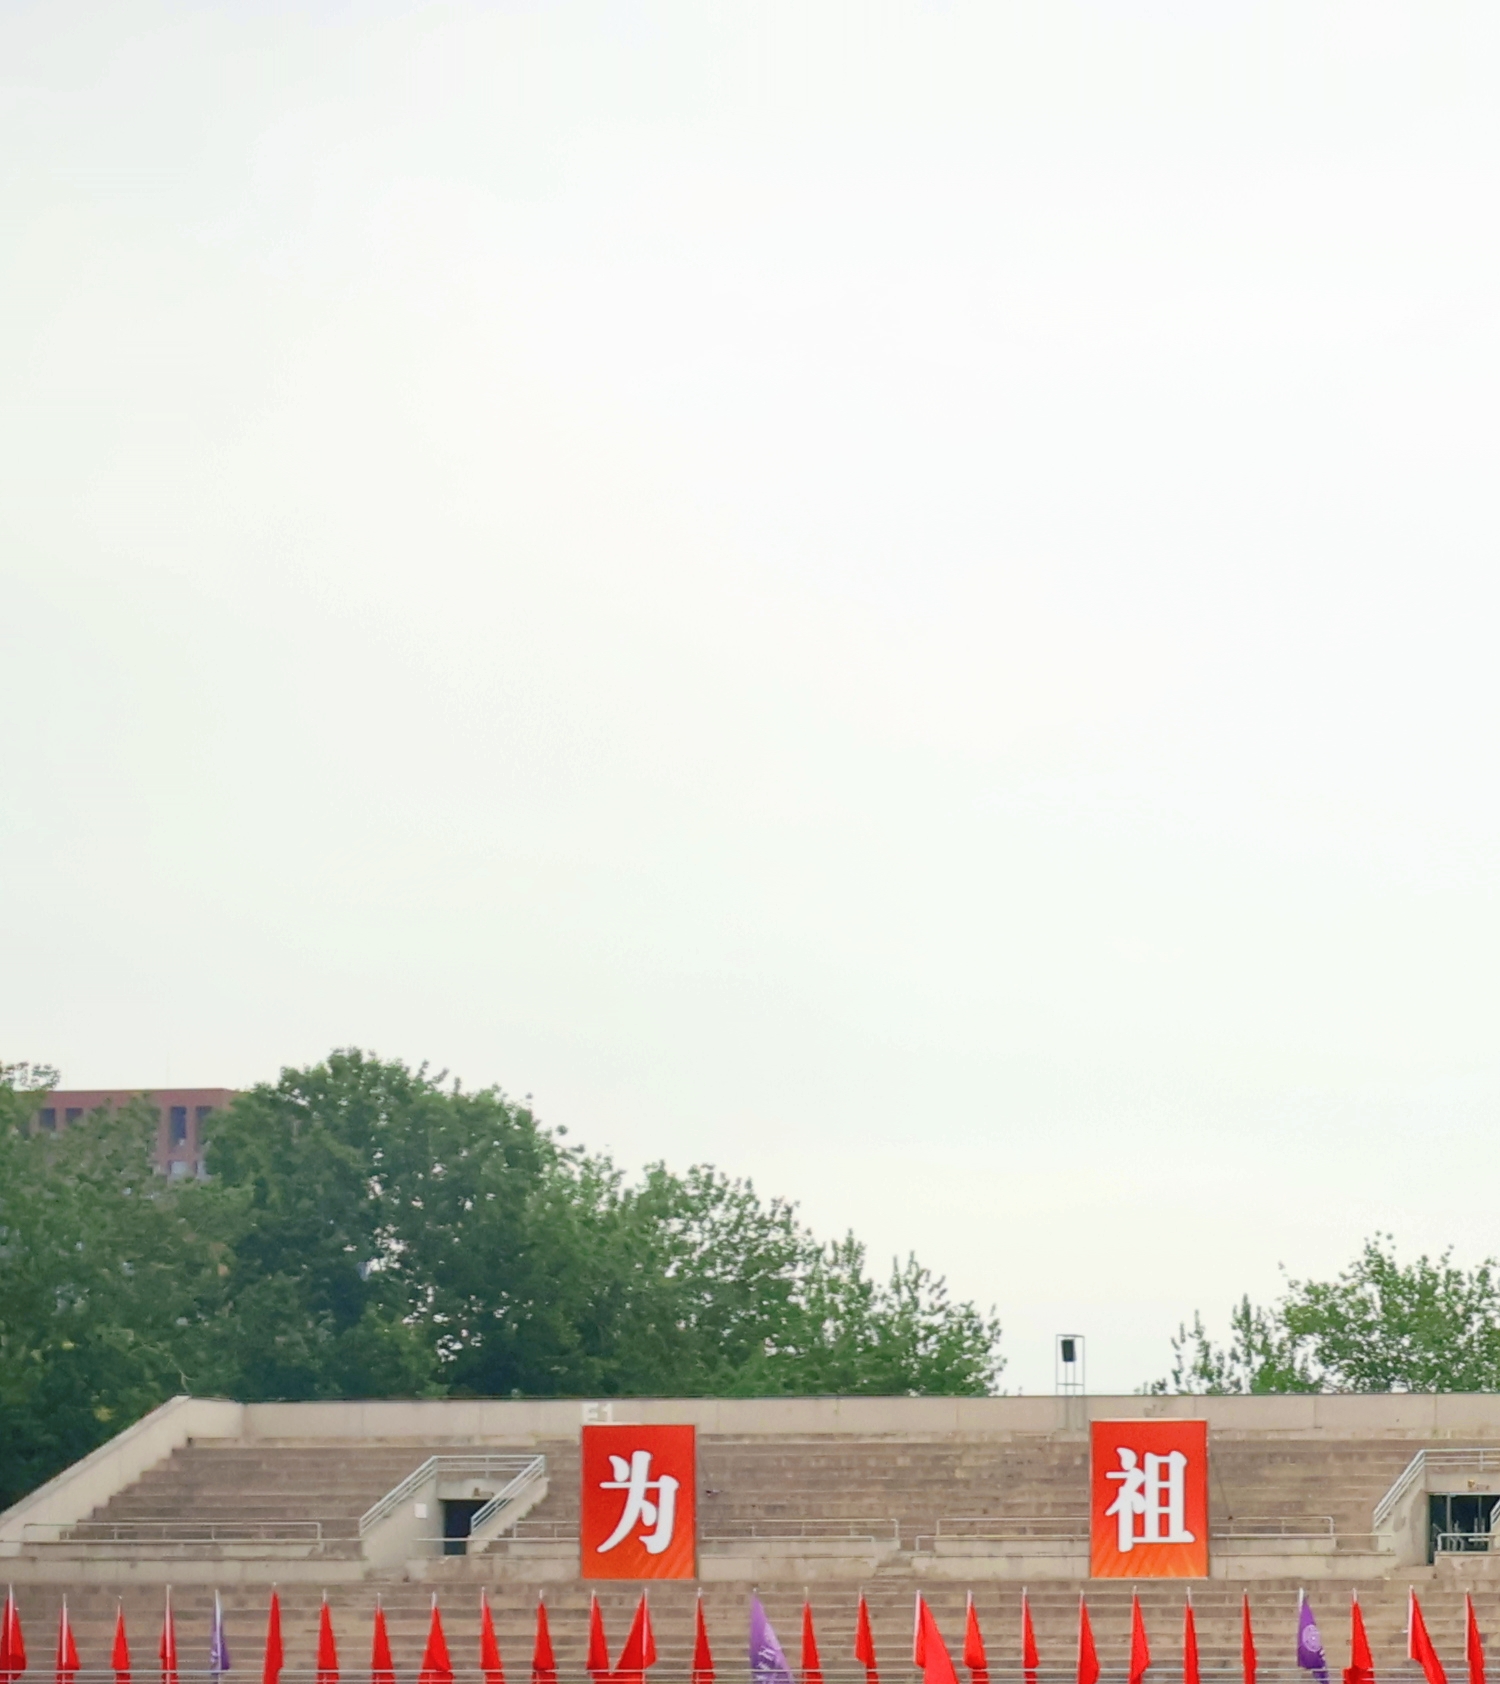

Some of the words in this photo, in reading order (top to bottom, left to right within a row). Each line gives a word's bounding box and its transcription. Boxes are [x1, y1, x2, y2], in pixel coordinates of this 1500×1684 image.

[581, 1402, 613, 1423] E1
[598, 1451, 678, 1553] 为
[1106, 1448, 1194, 1552] 祖
